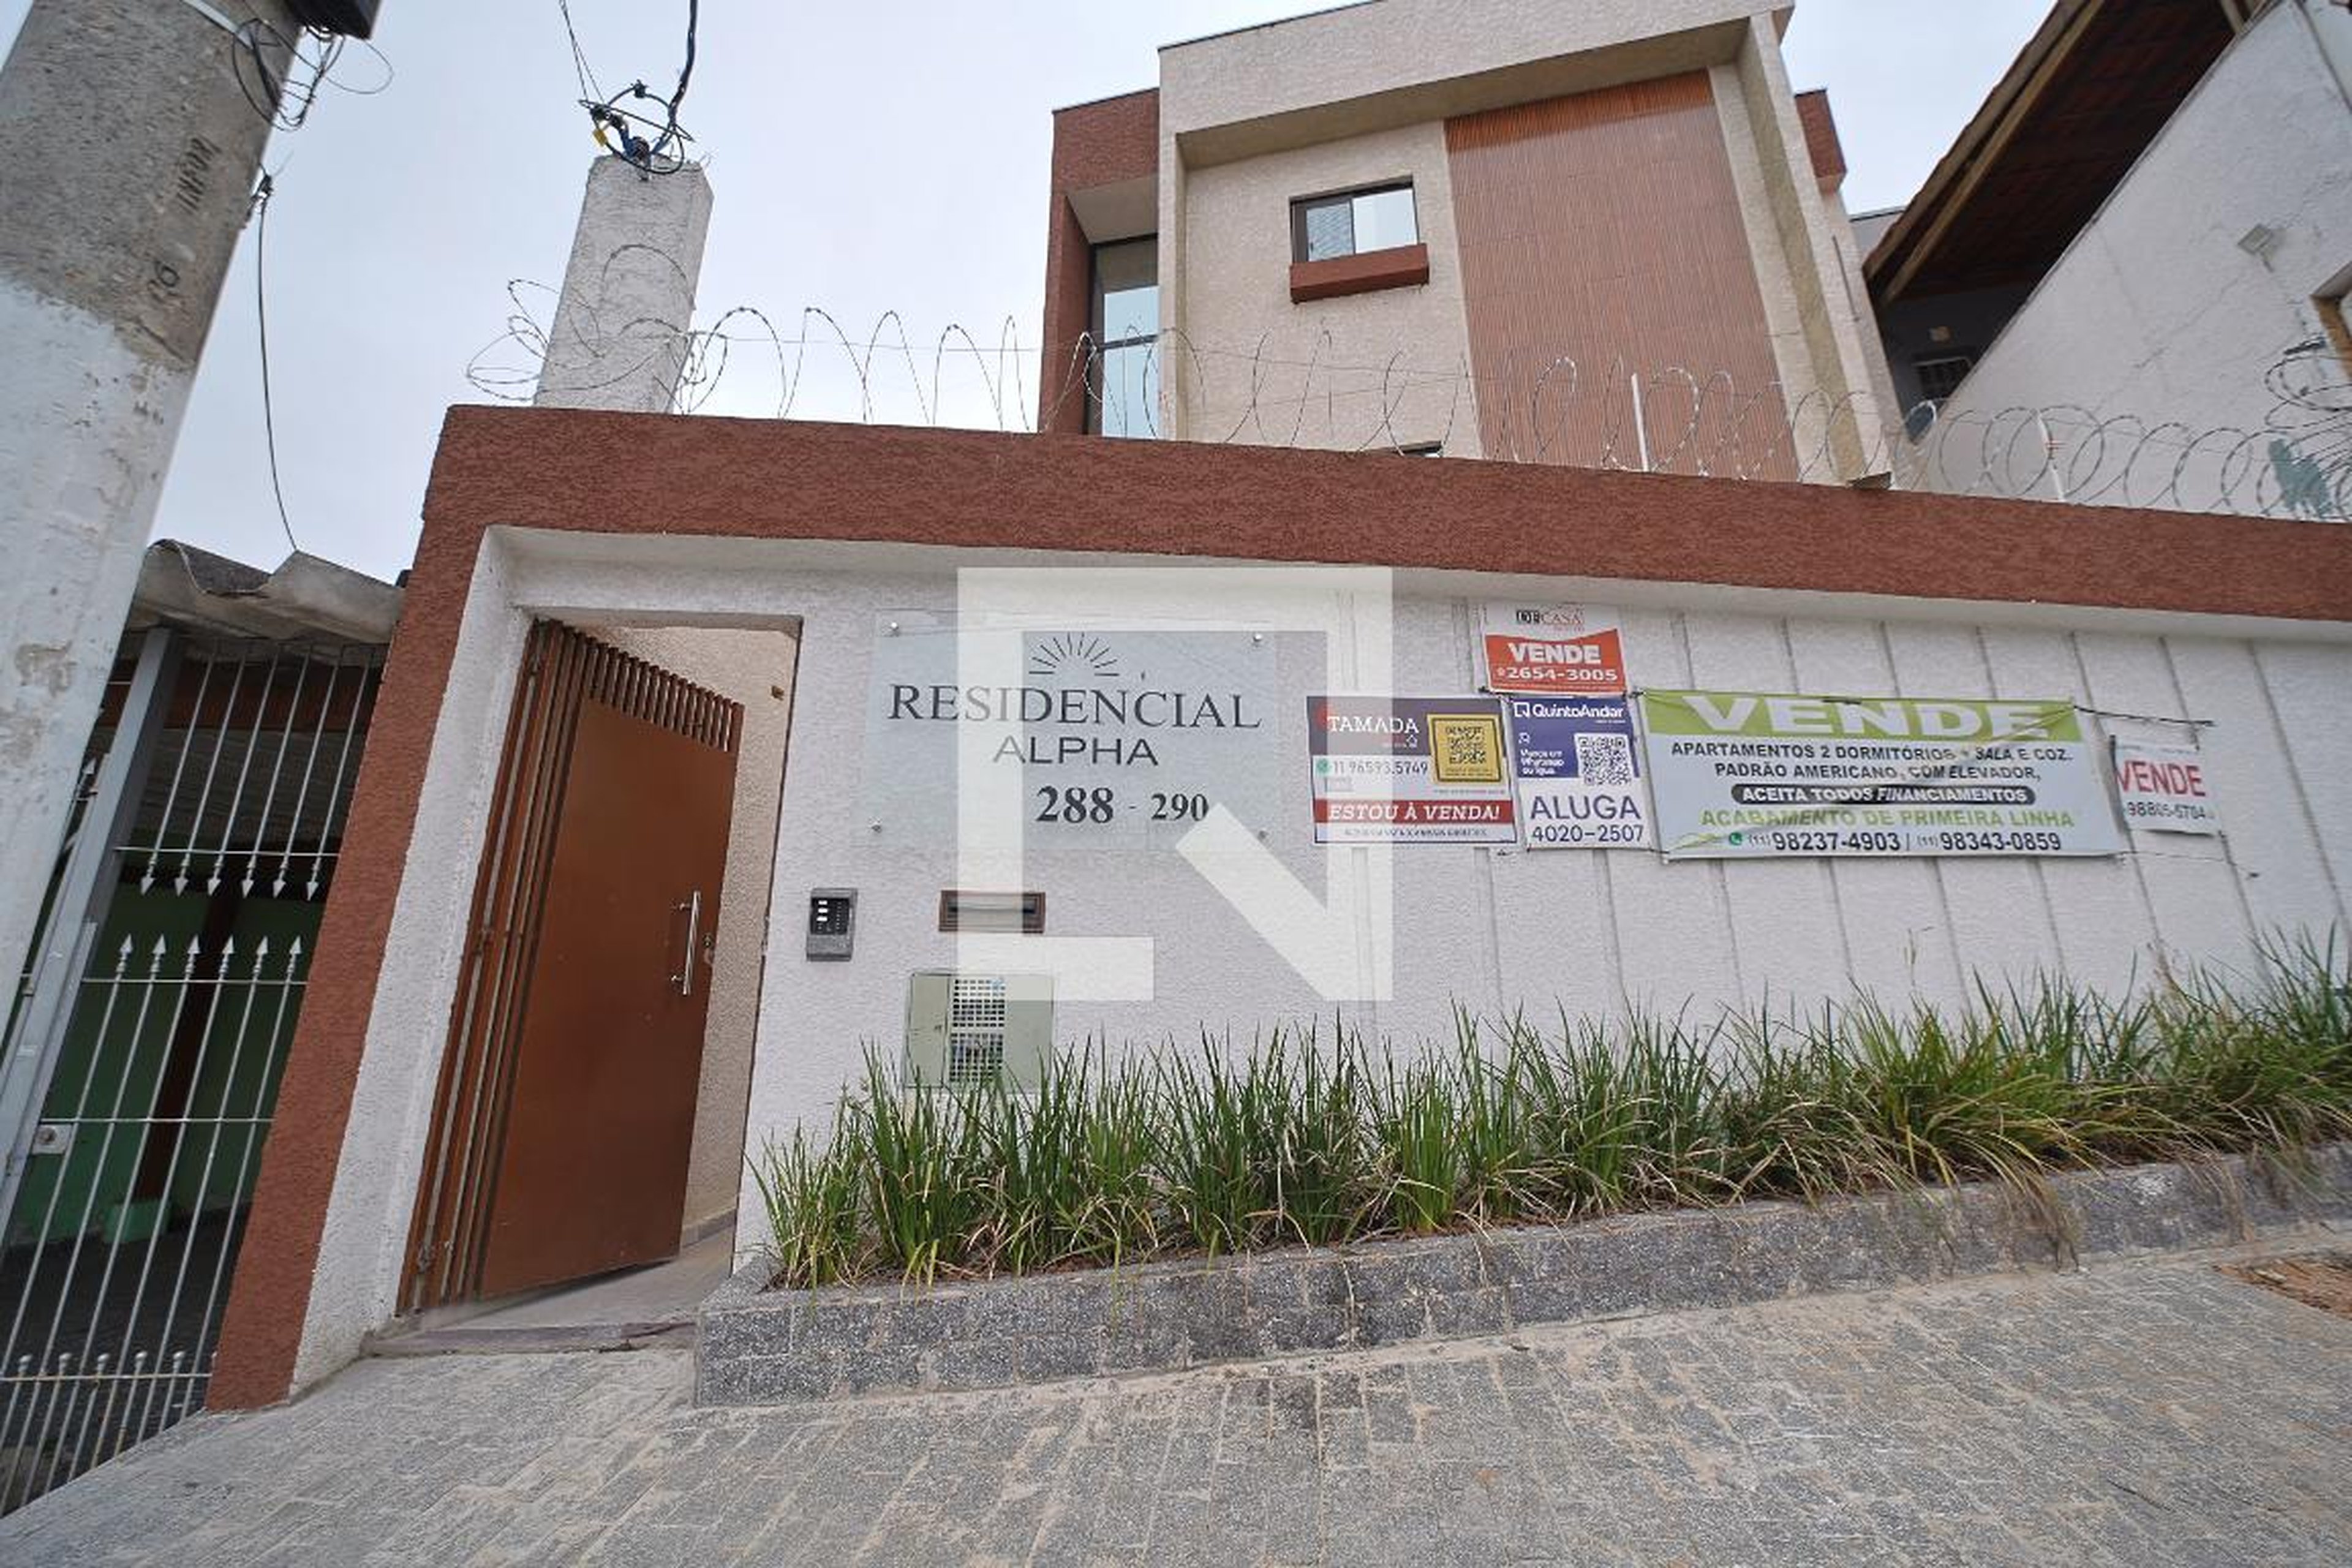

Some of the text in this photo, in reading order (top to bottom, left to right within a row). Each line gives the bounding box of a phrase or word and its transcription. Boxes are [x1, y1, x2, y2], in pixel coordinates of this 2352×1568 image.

[1507, 643, 1601, 664] VENDE
[1506, 666, 1618, 681] 2654-3005
[888, 684, 1262, 728] RESIDENCIAL
[1532, 704, 1623, 718] QuintoAndar
[1327, 715, 1419, 733] TAMADA
[1682, 696, 2048, 738] VENDE
[993, 735, 1159, 766] ALPHA
[1672, 742, 1814, 758] APARTAMENTOS
[1820, 745, 1831, 758] 2
[1837, 745, 1955, 760] DORMITÓRIOS
[1975, 748, 2011, 761] SALA
[2018, 749, 2029, 760] E
[1715, 761, 1787, 777] PADRÃO
[1950, 766, 2041, 781] ELEVADOR,
[2114, 760, 2206, 797] VENDE
[1743, 787, 2027, 802] ACEITA TODOS FINANCIAMENTOS
[1036, 786, 1114, 823] 288
[1152, 793, 1209, 821] 290
[1329, 801, 1501, 820] ESTOU À VENDA!
[1531, 794, 1641, 819] ALUGA
[1701, 809, 2075, 827] ACABAMENTO DE PRIMEIRA LINHA
[1532, 824, 1644, 842] 4020-2507
[1772, 832, 1899, 851] 98237-4903
[1940, 832, 2061, 851] 98343-0859
